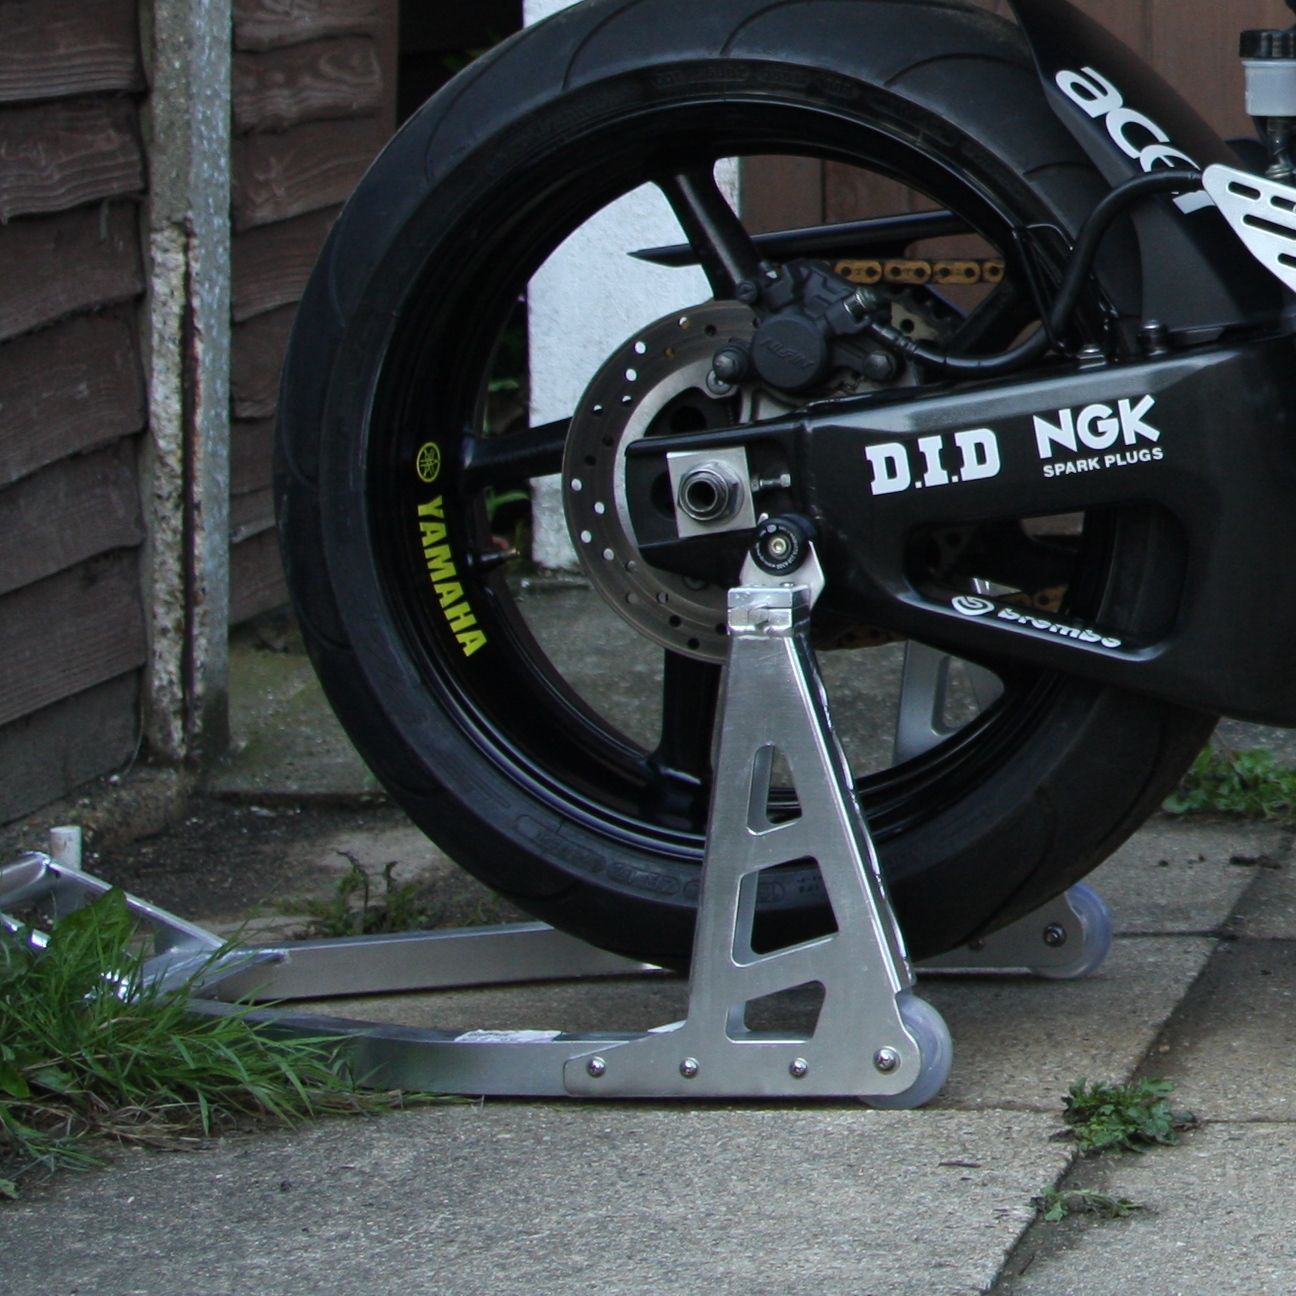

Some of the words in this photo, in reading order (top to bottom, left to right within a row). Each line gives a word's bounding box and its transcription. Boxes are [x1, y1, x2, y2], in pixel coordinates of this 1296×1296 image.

[1033, 394, 1161, 460] NGK
[865, 427, 1001, 496] D.I.D
[1043, 456, 1100, 478] SPARK
[1104, 446, 1164, 468] PLUGS
[417, 495, 488, 657] YAMAHA
